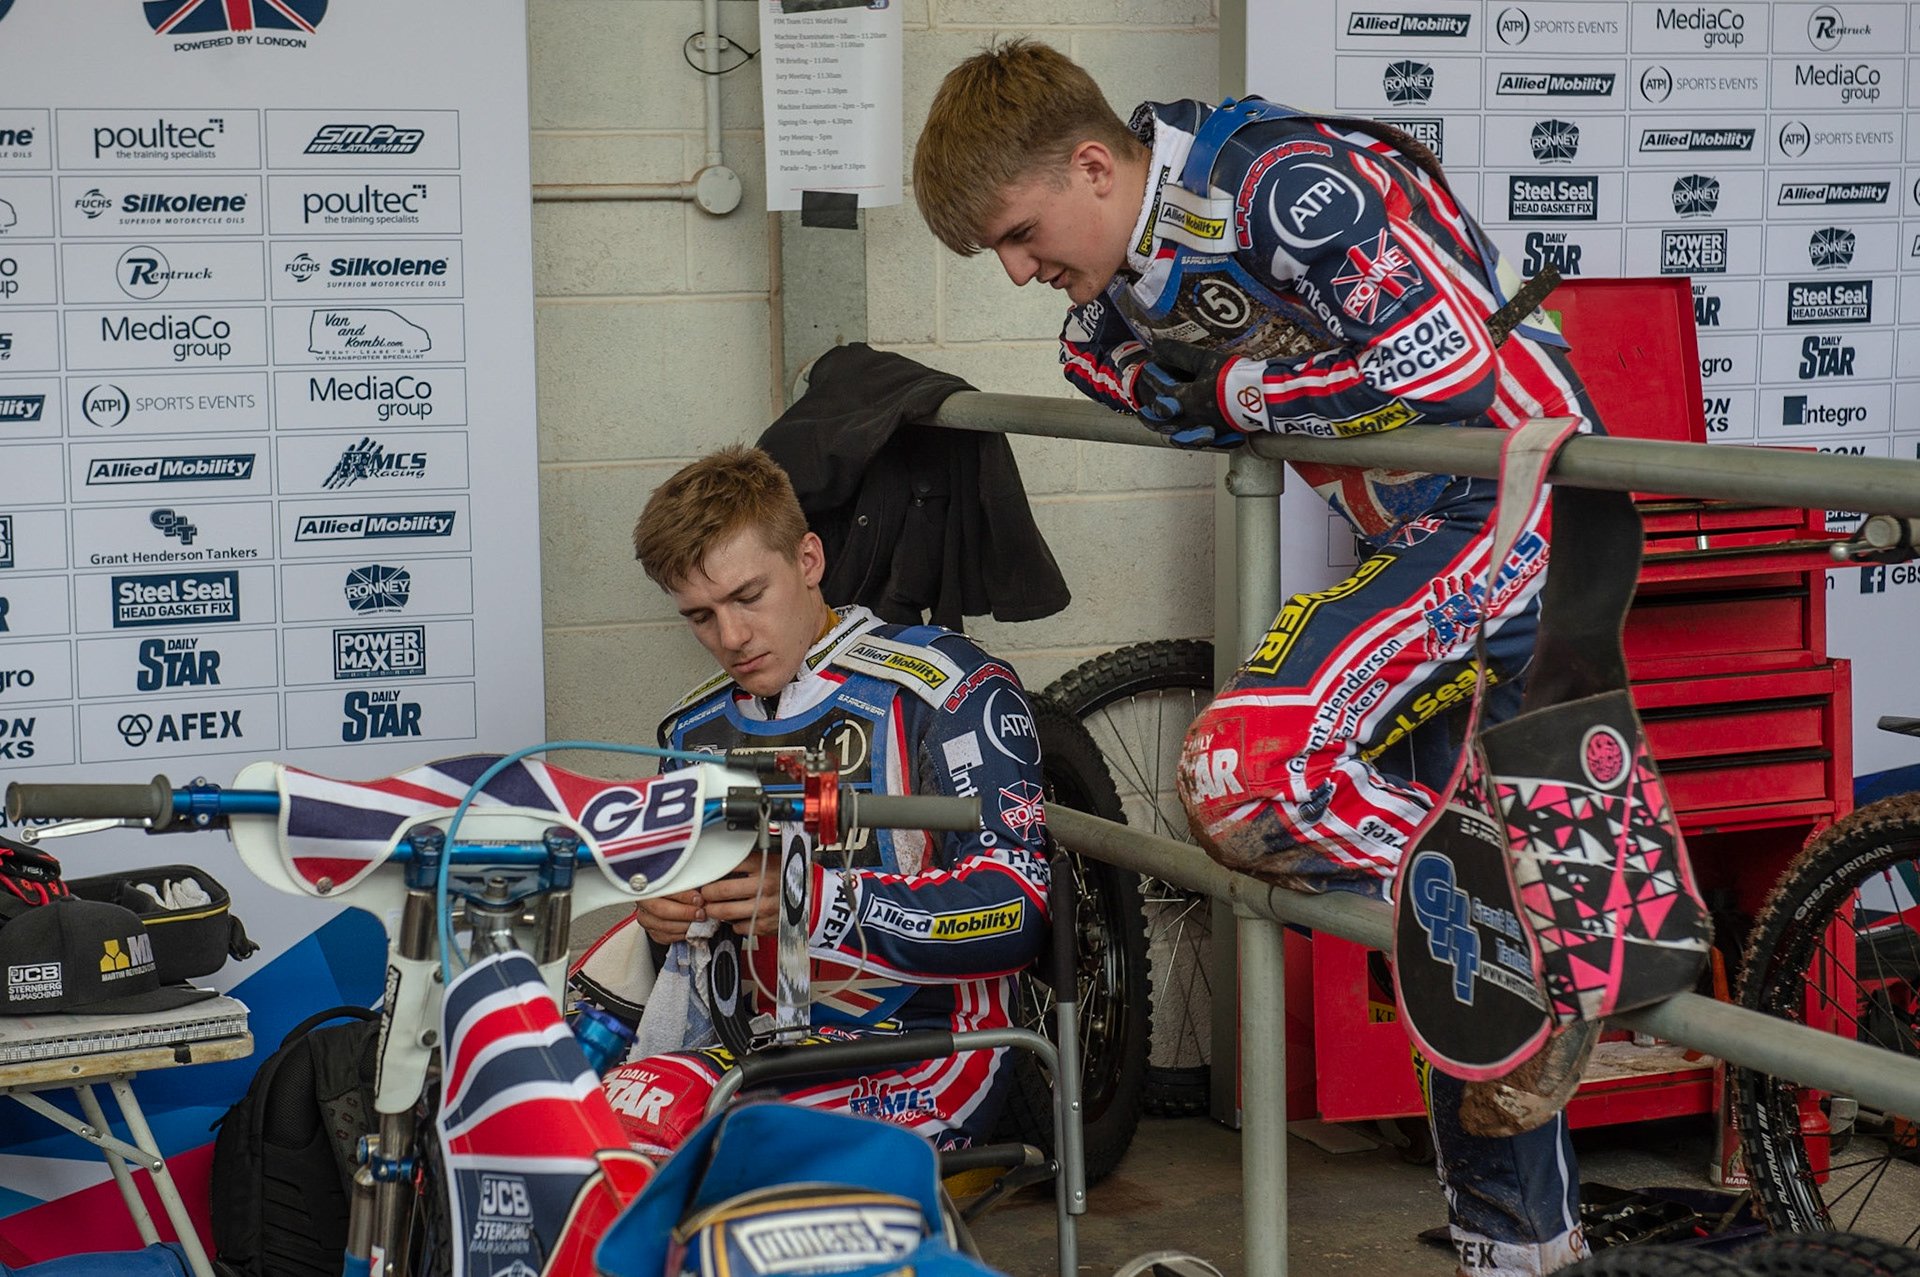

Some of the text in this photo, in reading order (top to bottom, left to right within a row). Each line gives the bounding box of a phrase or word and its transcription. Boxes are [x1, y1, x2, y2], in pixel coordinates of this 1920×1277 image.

[1353, 17, 1468, 34] Allied Mobility
[1502, 19, 1524, 32] ATPI
[1534, 20, 1618, 34] SPORTS EVENTS
[1656, 8, 1744, 30] MediaCo
[1815, 16, 1871, 39] Rentruck
[174, 36, 307, 52] POWERED BY LONDON
[1703, 31, 1744, 48] group
[786, 57, 808, 65] Briefing
[1383, 75, 1434, 90] RONNEY
[1645, 78, 1667, 90] ATPI
[1676, 77, 1758, 90] SPORTS EVENTS
[1795, 64, 1881, 86] MediaCo
[804, 88, 821, 96] 12pm
[1501, 77, 1612, 94] Allied Mobility
[1841, 86, 1881, 104] group
[94, 119, 215, 159] poultec
[1531, 135, 1578, 149] RONNEY
[1644, 132, 1751, 149] Allied Mobility
[1784, 133, 1805, 145] ATPI
[1814, 132, 1894, 145] SPORTS EVENTS
[116, 150, 216, 161] the training specialists
[330, 143, 394, 154] PLATINUM
[790, 149, 812, 157] Briefing
[804, 164, 817, 172] 7pm
[1514, 180, 1594, 200] Steel Seal
[1672, 189, 1719, 204] RONNEY
[1783, 186, 1887, 202] Allied Mobility
[75, 199, 112, 209] FUCHS
[121, 193, 246, 214] Silkolene
[303, 184, 419, 224] poultec
[1289, 177, 1345, 233] ATPI
[1514, 203, 1592, 214] HEAD GASKET FIX
[324, 215, 419, 225] the training specialists
[1184, 213, 1223, 237] Mobility
[1545, 233, 1567, 243] DAILY
[1665, 234, 1722, 250] POWER
[1809, 241, 1855, 256] RONNEY
[285, 263, 321, 273] FUCHS
[329, 257, 448, 277] Silkolene
[1665, 250, 1722, 268] MAXED
[126, 258, 213, 286] Rentruck
[1204, 287, 1239, 320] 5
[1792, 285, 1868, 306] Steel Seal
[324, 313, 351, 327] Van
[1792, 307, 1866, 318] HEAD GASKET FIX
[102, 315, 231, 342] MediaCo
[337, 324, 366, 337] and
[1821, 336, 1842, 347] DAILY
[173, 342, 232, 362] group
[1363, 330, 1466, 388] SHOCKS
[1798, 336, 1856, 380] STAR
[310, 376, 433, 402] MediaCo
[90, 399, 121, 412] ATPI
[136, 395, 255, 411] SPORTS EVENTS
[377, 402, 433, 421] group
[1282, 402, 1410, 438] Allied Mobility
[1801, 404, 1867, 426] integro
[93, 459, 251, 478] Allied Mobility
[368, 468, 425, 479] Racing
[302, 516, 451, 534] Allied Mobility
[90, 548, 258, 565] Grant Henderson Tankers
[118, 577, 233, 604] Steel Seal
[346, 579, 410, 599] RONNEY
[120, 602, 232, 619] HEAD GASKET FIX
[1253, 559, 1384, 662] POWER
[167, 637, 199, 651] DAILY
[340, 631, 419, 652] POWER
[136, 638, 221, 691] STAR
[340, 649, 420, 671] MAXED
[852, 645, 891, 662] Allied
[888, 655, 942, 687] Mobility
[1318, 638, 1403, 724] Henderson
[371, 690, 401, 703] DAILY
[342, 690, 422, 742] STAR
[1333, 679, 1387, 743] Tankers
[156, 709, 243, 743] AFEX
[1000, 713, 1036, 739] ATPI
[834, 729, 851, 765] 1
[581, 778, 699, 842] GB
[1794, 844, 1895, 921] GREAT BRITAIN
[823, 885, 852, 949] AFEX
[872, 906, 1020, 936] Allied Mobility
[11, 965, 60, 983] JCB
[8, 982, 63, 995] STERNBERG
[9, 990, 63, 1002] BAUMASCHINEN
[619, 1069, 660, 1083] DAILY
[483, 1180, 531, 1216] JCB
